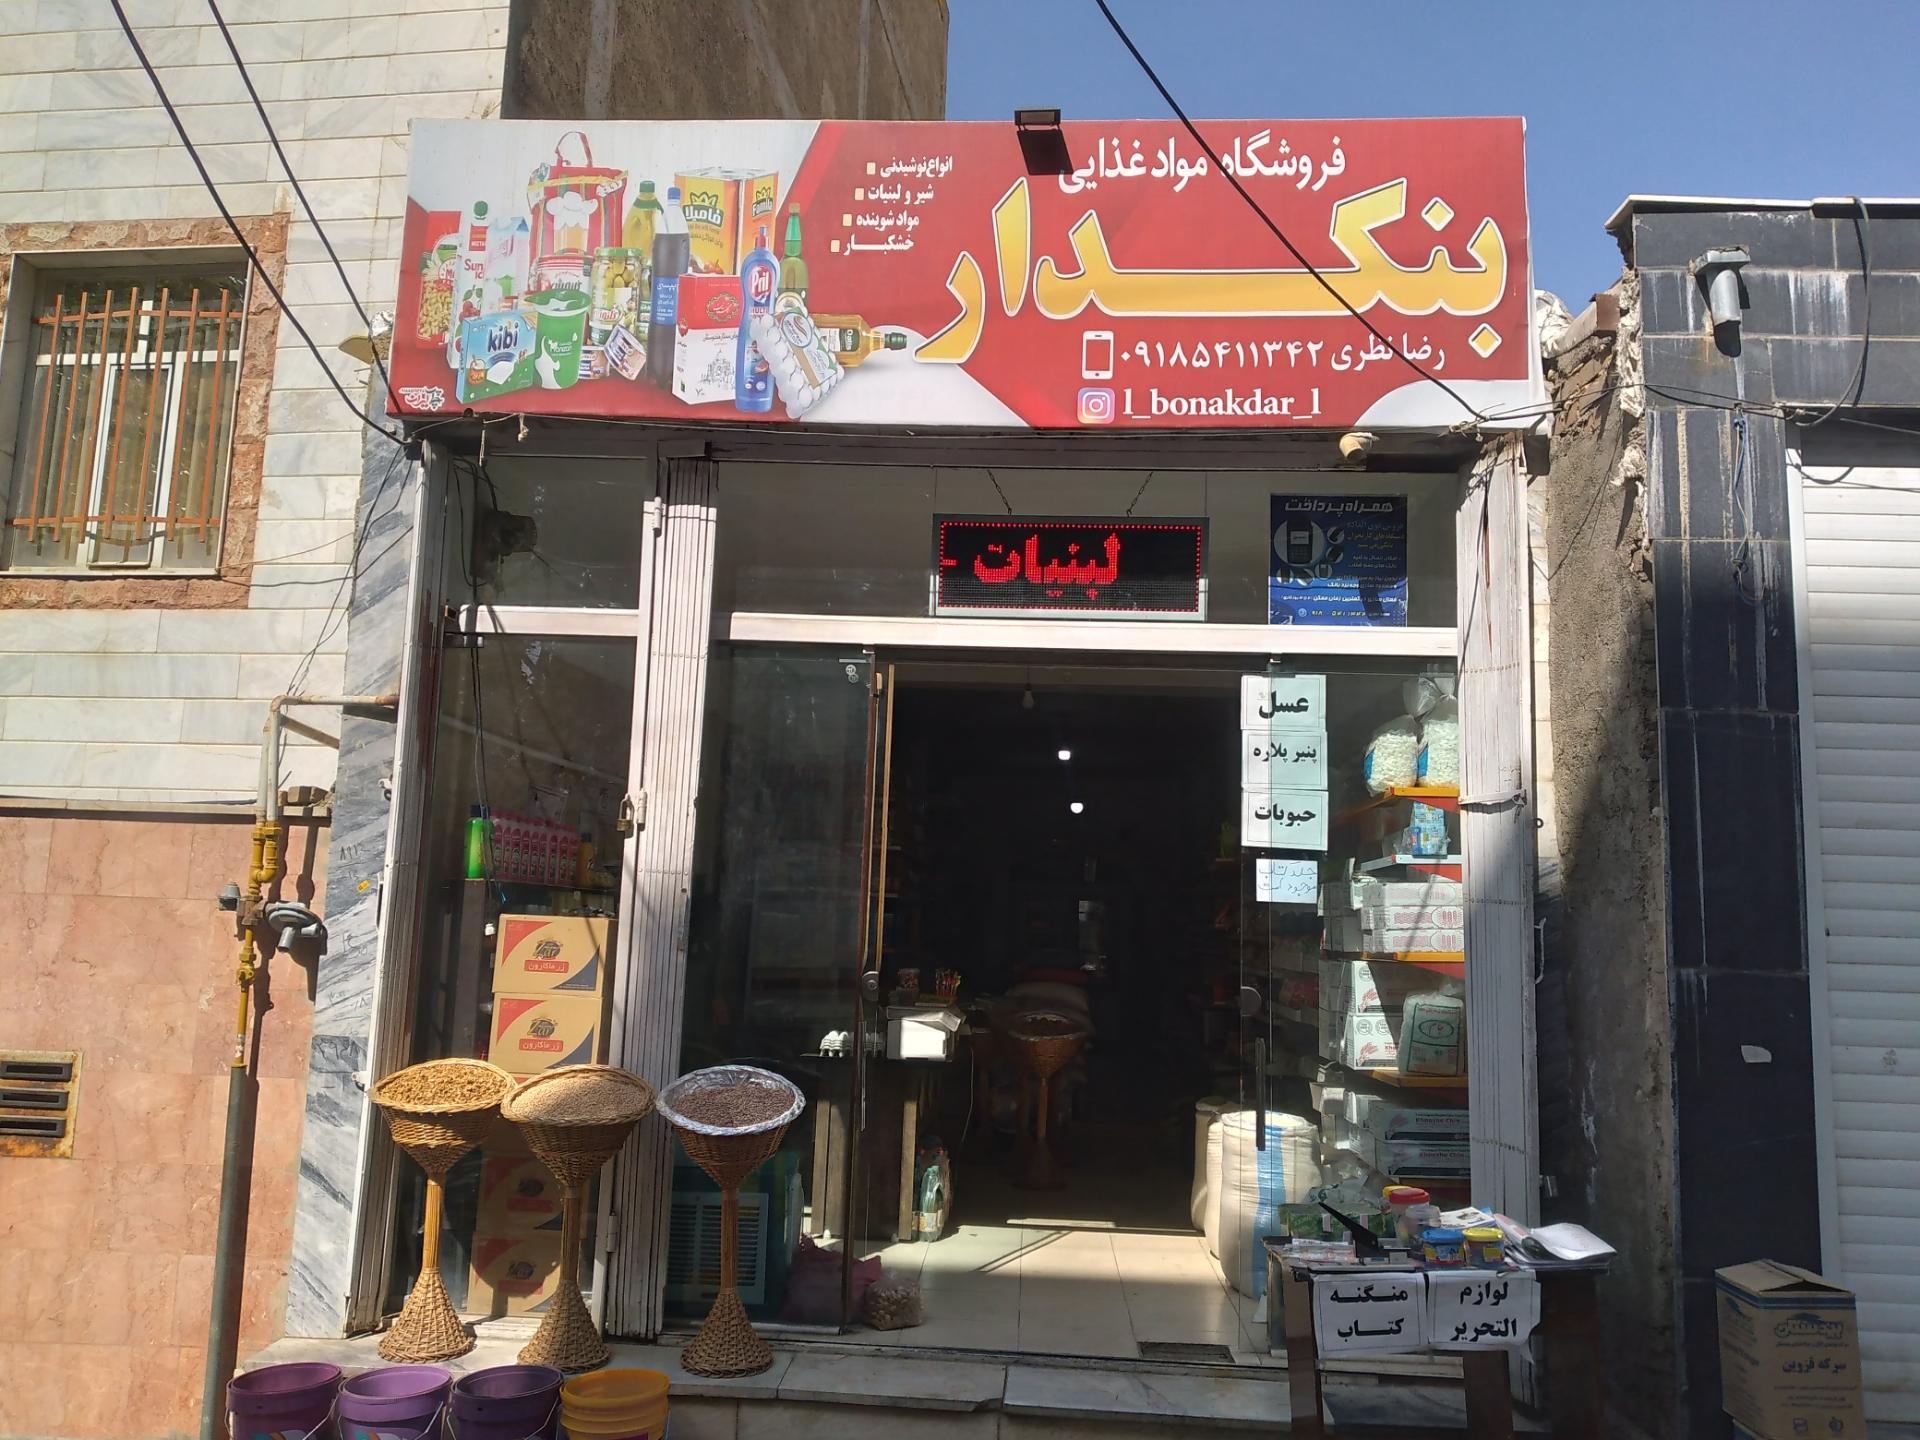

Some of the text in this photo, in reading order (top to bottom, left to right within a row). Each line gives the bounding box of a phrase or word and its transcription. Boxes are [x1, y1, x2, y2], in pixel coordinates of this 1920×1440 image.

[880, 156, 953, 178] انواع نوشیدنی
[1058, 129, 1346, 193] فروشگاه مواد غذایی
[868, 183, 934, 205] شیر و لبنیات
[856, 210, 920, 231] مواد شوینده
[843, 234, 914, 256] خشکبار
[751, 266, 769, 293] Pril
[487, 320, 519, 353] kibi
[1121, 333, 1445, 371] رضا نظری ۰۹۱۸۵۴۱۱۳۴۲
[1285, 498, 1393, 517] همراه پرداخت
[974, 533, 1120, 600] لبنیات
[1258, 691, 1310, 719] عسل
[1253, 740, 1317, 763] پنیر پلاره
[1254, 803, 1317, 827] حبوبات
[1330, 1286, 1408, 1304] منگنه
[1459, 1280, 1509, 1305] لوازم
[1337, 1319, 1404, 1339] کتاب
[1450, 1318, 1517, 1342] التحریر
